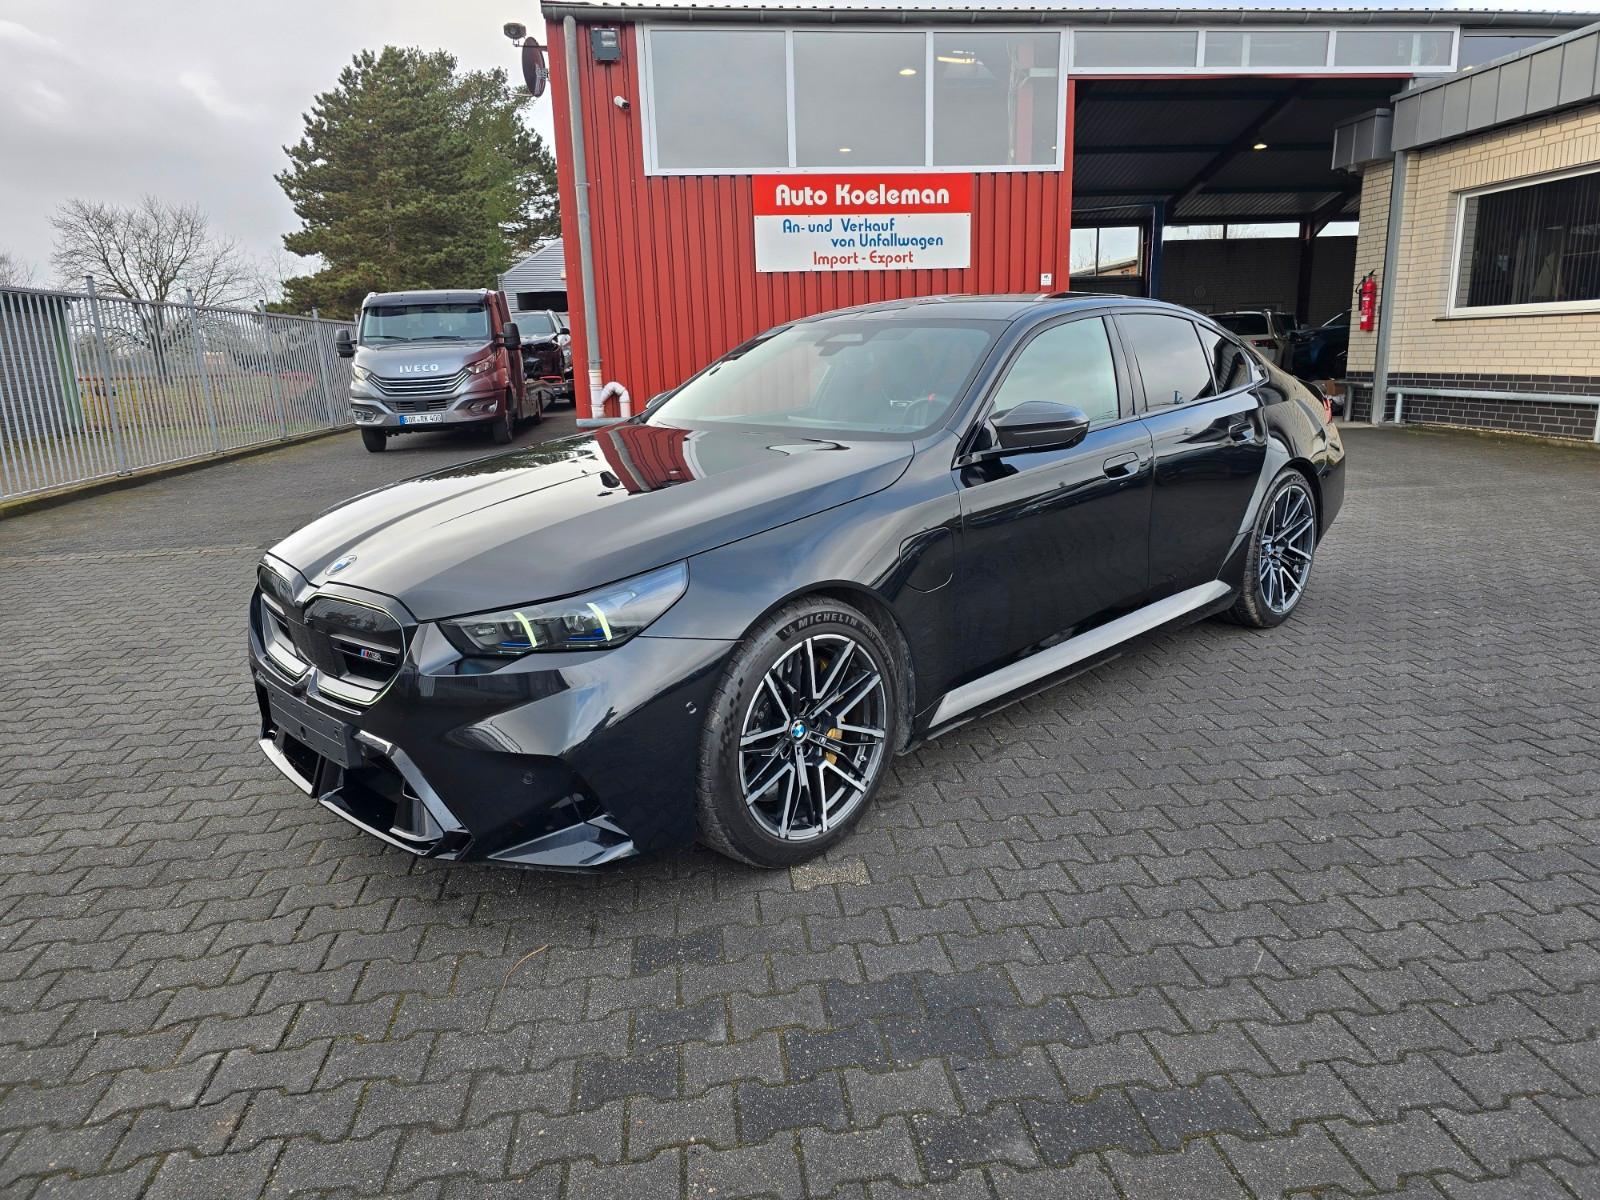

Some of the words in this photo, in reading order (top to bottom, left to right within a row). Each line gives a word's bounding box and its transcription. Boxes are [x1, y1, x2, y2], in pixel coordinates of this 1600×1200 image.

[775, 184, 828, 206] Auto
[835, 183, 950, 205] Koeleman
[782, 218, 805, 234] An-
[808, 219, 833, 233] und
[840, 217, 896, 232] Verkauf
[831, 236, 855, 248] von
[859, 232, 944, 250] Unfallwagen
[813, 251, 859, 268] Import
[869, 250, 914, 267] Export
[399, 363, 439, 374] IVECO
[798, 613, 858, 629] MICHELIN
